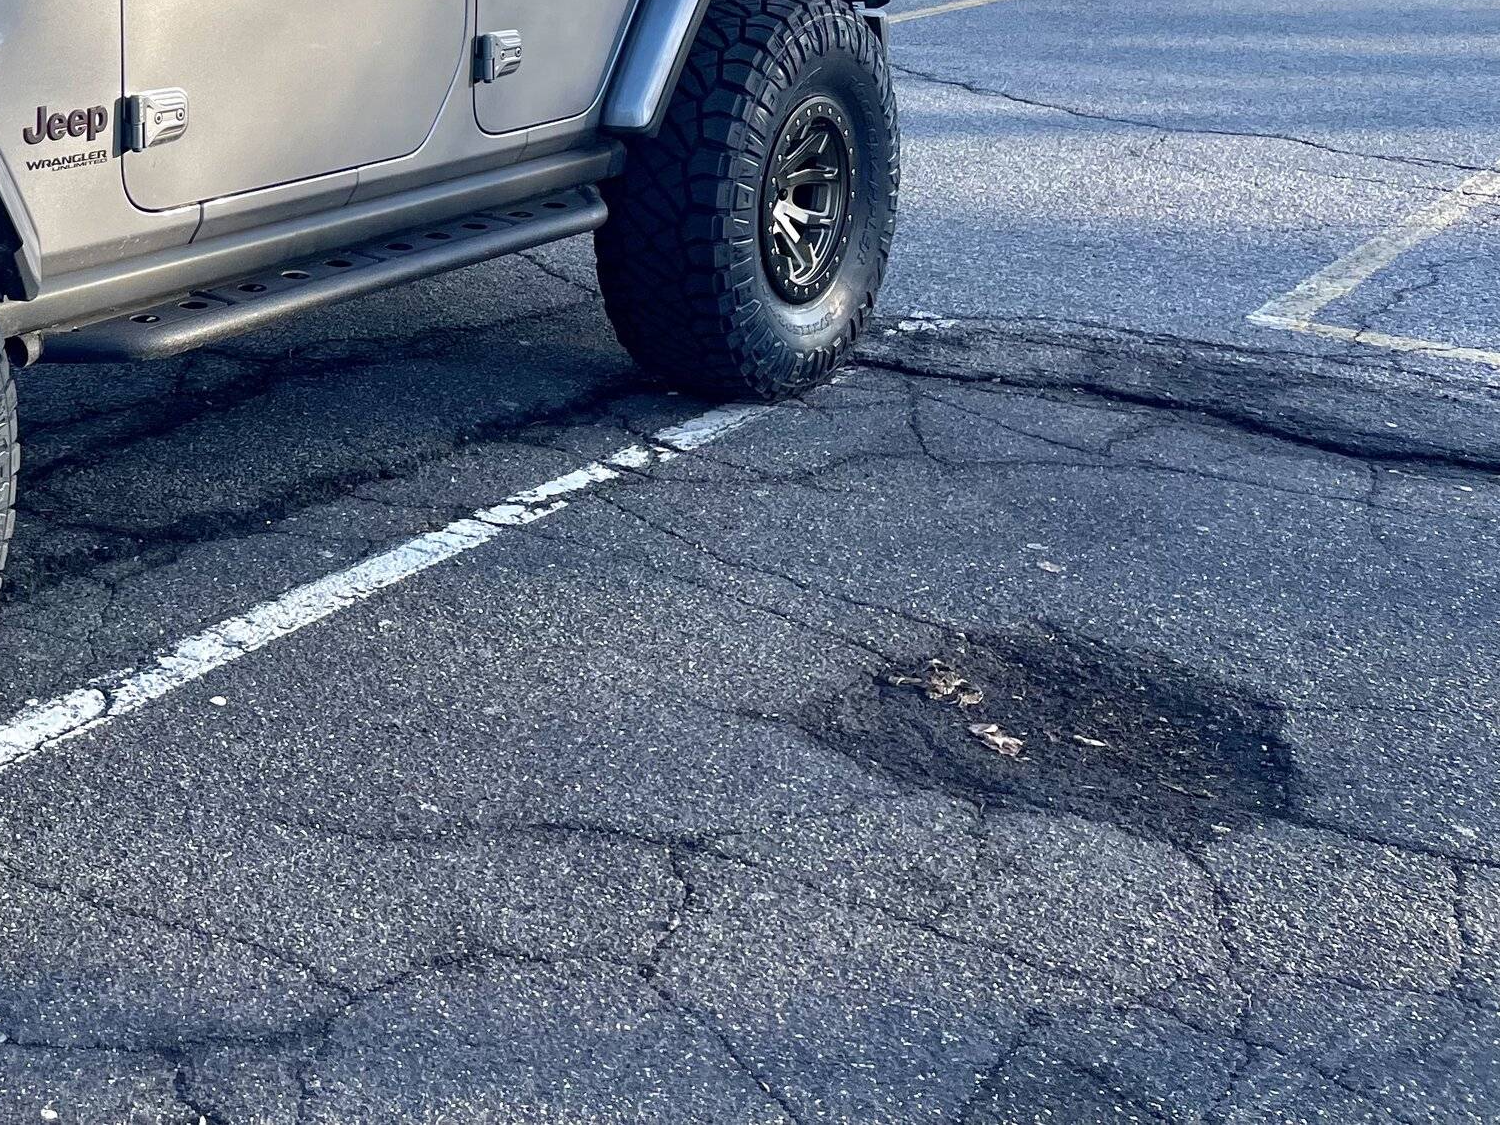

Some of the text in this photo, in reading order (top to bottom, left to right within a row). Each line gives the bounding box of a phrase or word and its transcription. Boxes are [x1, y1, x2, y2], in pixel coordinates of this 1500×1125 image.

[23, 105, 108, 145] Jeep
[26, 149, 107, 171] WRANGLER
[52, 159, 108, 172] UNLIMITED
